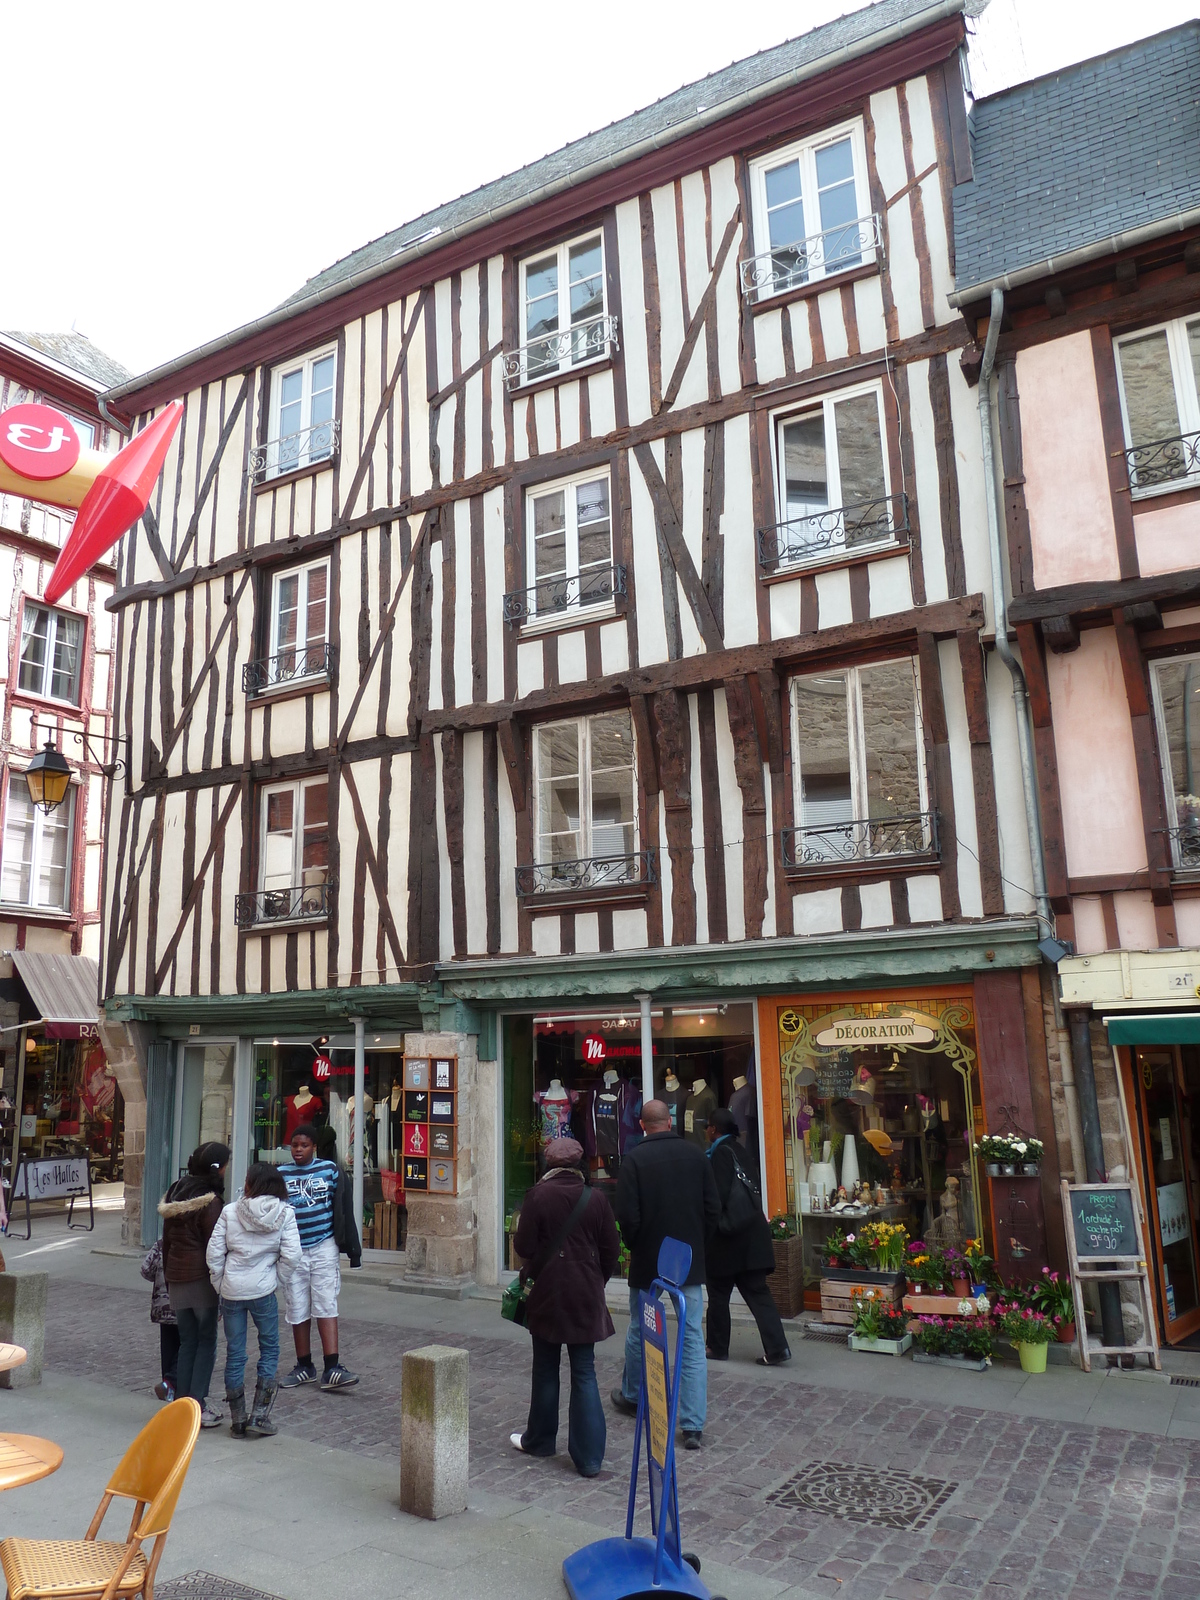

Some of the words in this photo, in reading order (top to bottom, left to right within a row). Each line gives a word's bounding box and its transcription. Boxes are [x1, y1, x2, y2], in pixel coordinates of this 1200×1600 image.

[1175, 977, 1187, 986] 21
[835, 1024, 915, 1040] DÉCORATION
[32, 1167, 51, 1194] Les
[52, 1164, 80, 1186] Halles
[1089, 1194, 1116, 1203] PROMO
